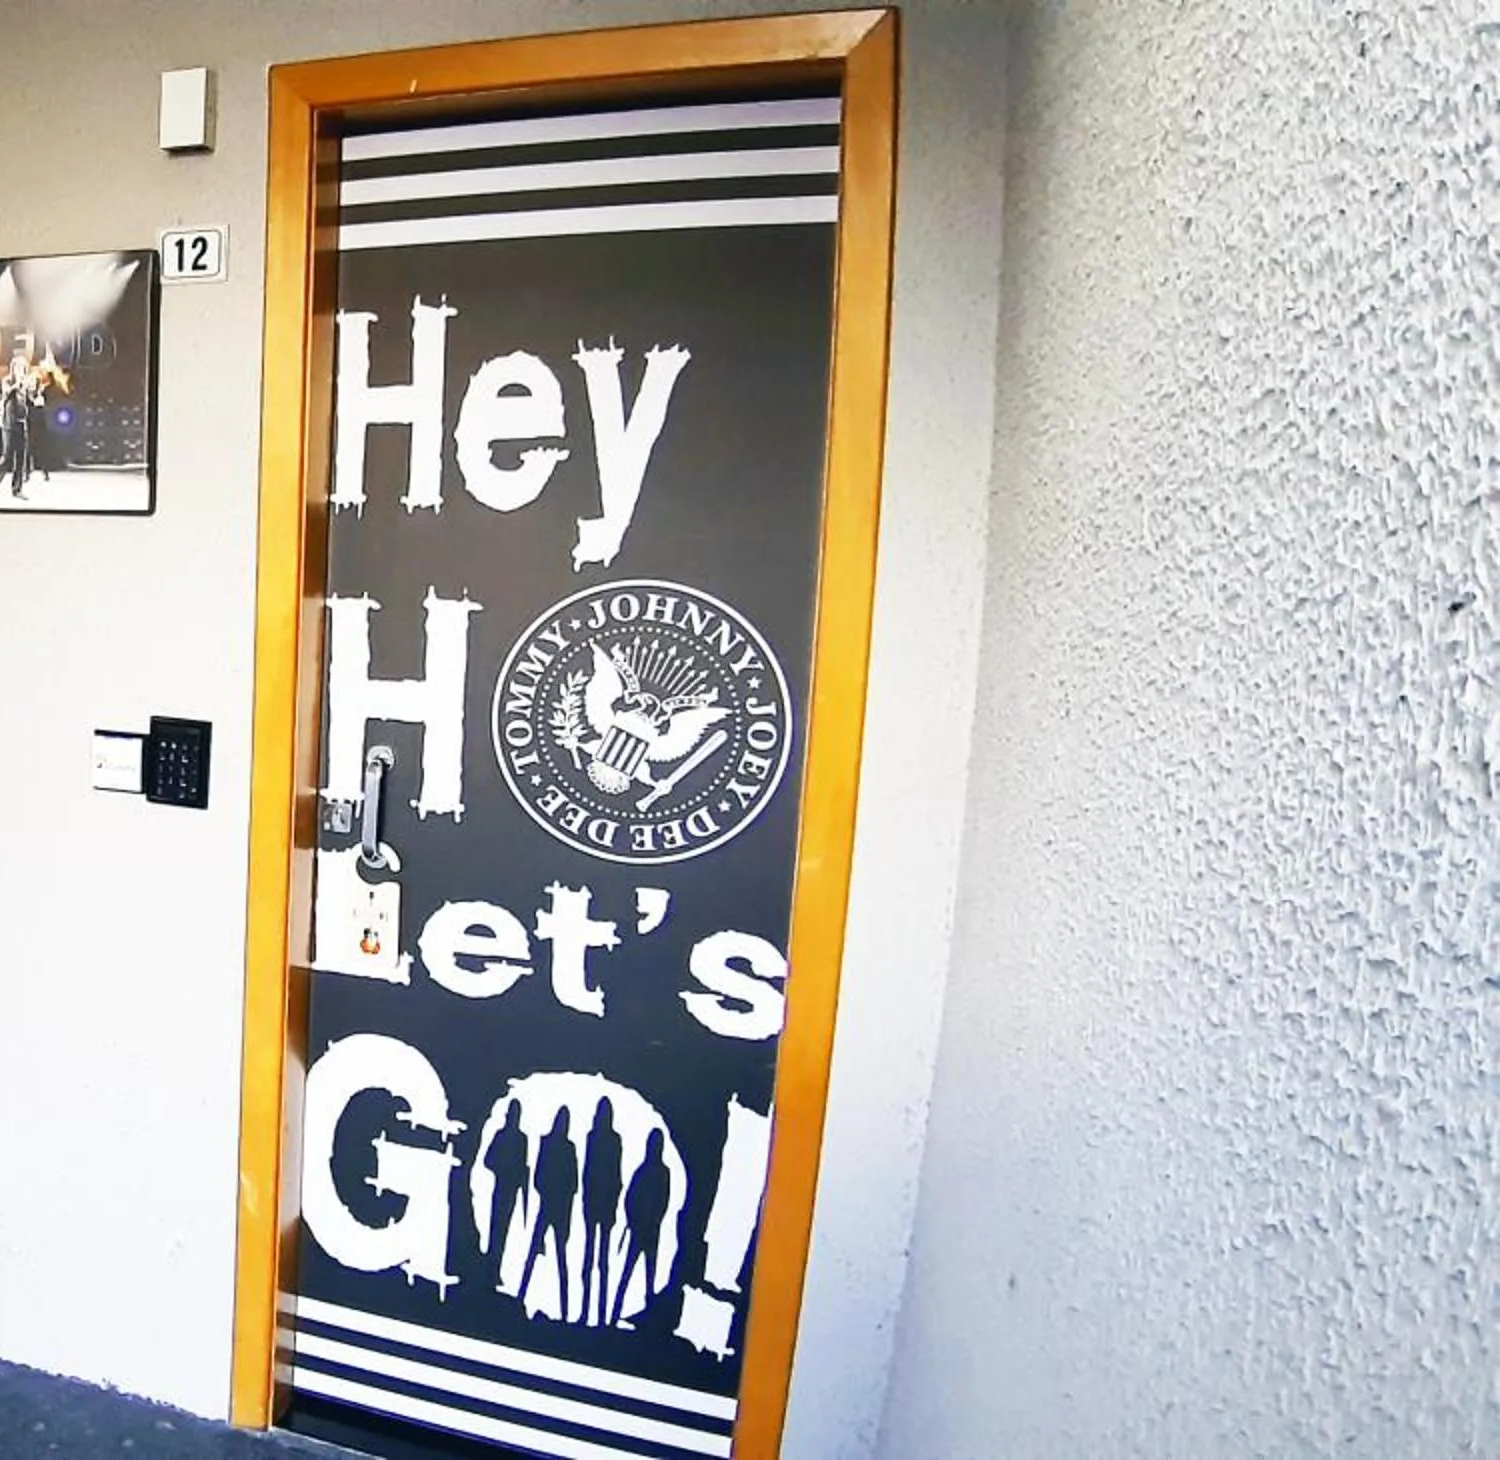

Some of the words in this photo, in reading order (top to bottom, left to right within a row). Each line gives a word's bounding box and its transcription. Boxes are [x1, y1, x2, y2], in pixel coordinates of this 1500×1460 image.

[174, 236, 210, 272] 12
[331, 294, 691, 572] Hey
[587, 593, 764, 676] JOHNNY
[505, 620, 570, 775] TOMMY
[726, 697, 778, 808] JOEY
[535, 784, 620, 848] DEE
[629, 806, 720, 850] DEE
[310, 845, 790, 1040] Let's
